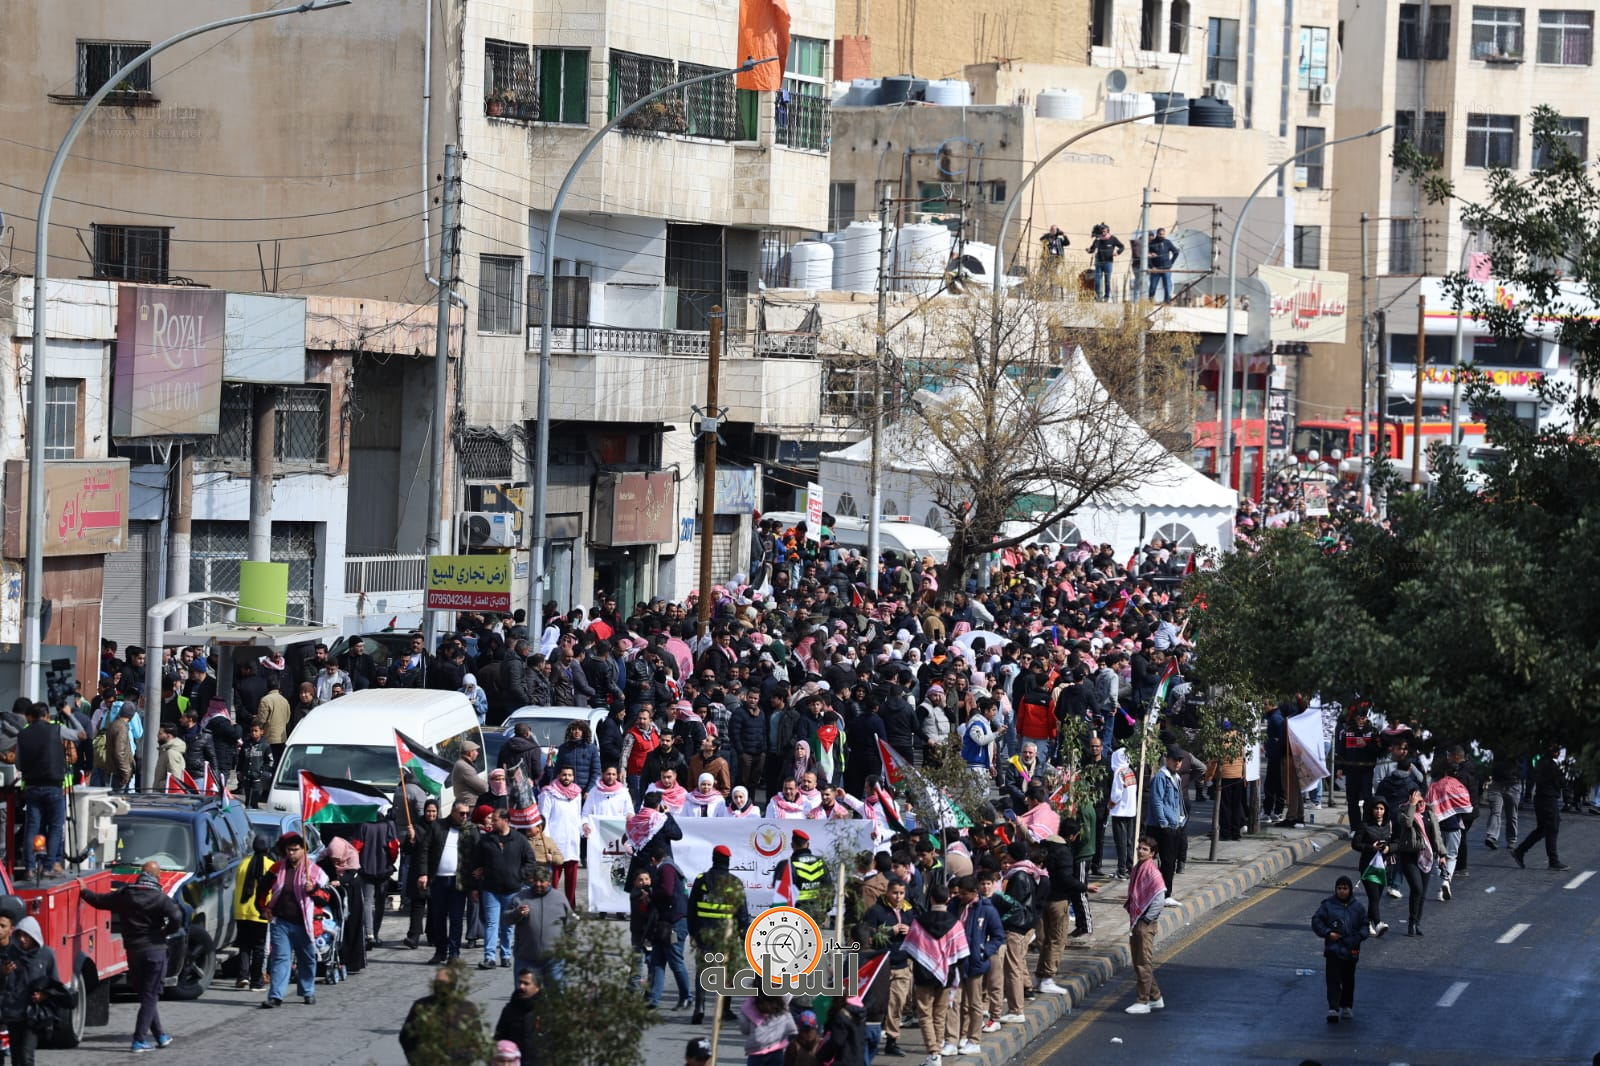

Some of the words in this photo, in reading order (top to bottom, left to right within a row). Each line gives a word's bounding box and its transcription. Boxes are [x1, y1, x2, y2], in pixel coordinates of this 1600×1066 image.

[152, 303, 206, 369] ROYAL
[150, 382, 201, 411] SALOON
[432, 564, 455, 585] للبيع
[456, 565, 485, 585] تجاري
[487, 564, 507, 585] أرض
[430, 593, 472, 606] 0795042344
[728, 860, 758, 872] التخص
